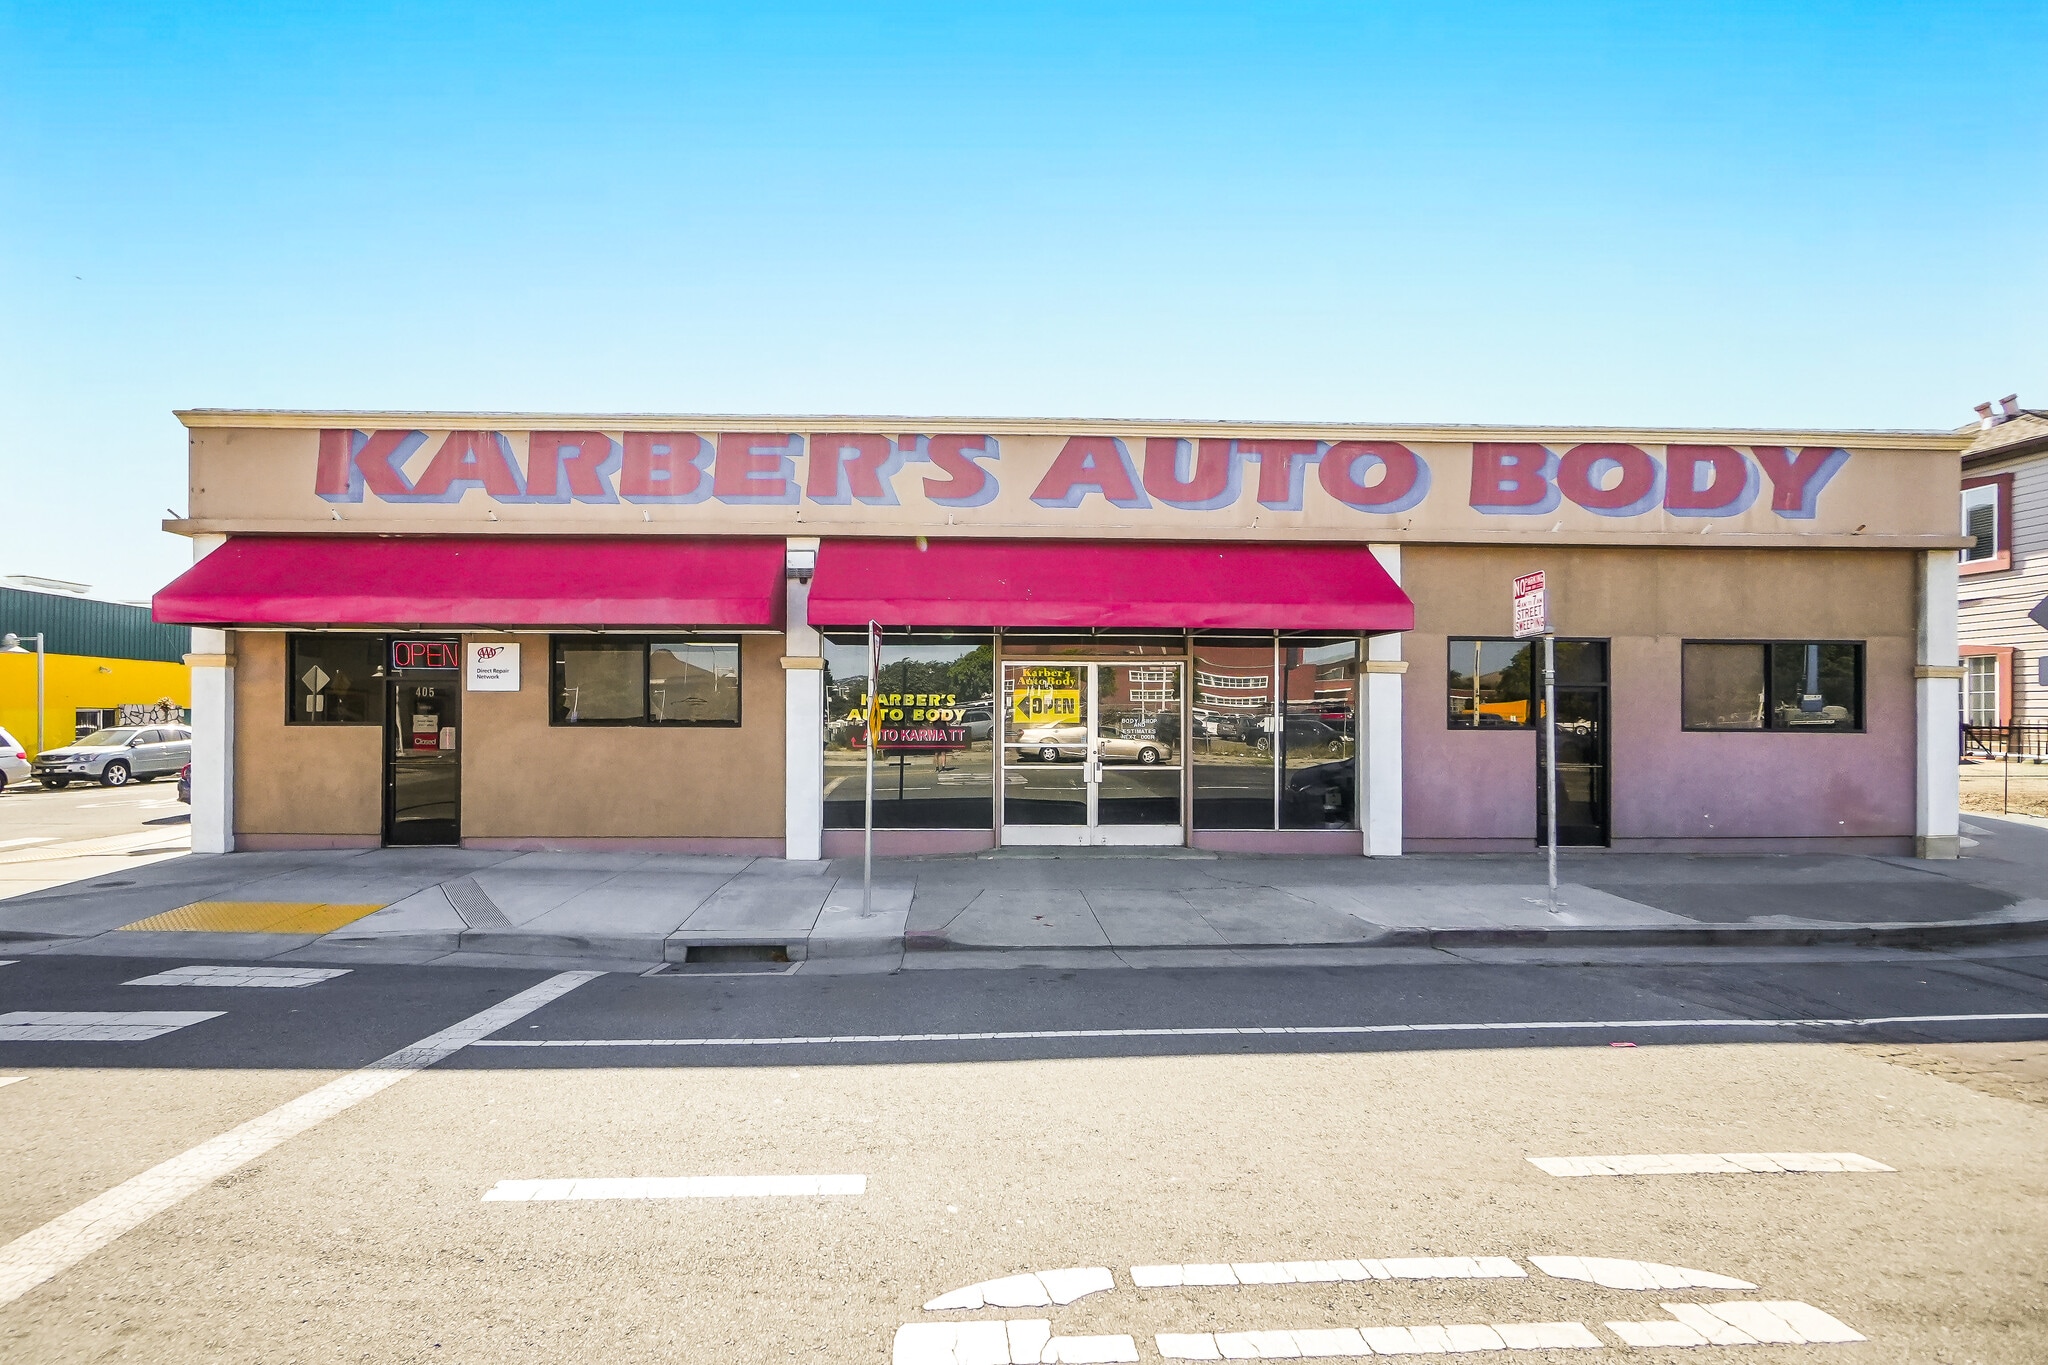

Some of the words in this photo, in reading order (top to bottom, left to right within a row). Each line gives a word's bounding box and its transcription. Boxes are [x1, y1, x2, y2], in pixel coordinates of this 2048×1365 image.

[315, 430, 1000, 508] KARBER'S
[1029, 435, 1433, 515] AUTO
[1470, 441, 1850, 520] BODY
[1515, 579, 1526, 597] NO
[1516, 605, 1542, 620] STREET
[1515, 616, 1544, 632] SWEEPING
[395, 642, 459, 667] OPEN
[477, 646, 496, 659] AAA
[1022, 668, 1071, 678] Karber's
[415, 687, 435, 698] 405
[1032, 697, 1075, 714] OPEN
[913, 708, 966, 722] BODY
[862, 729, 898, 741] ATO
[900, 729, 945, 741] KARMA
